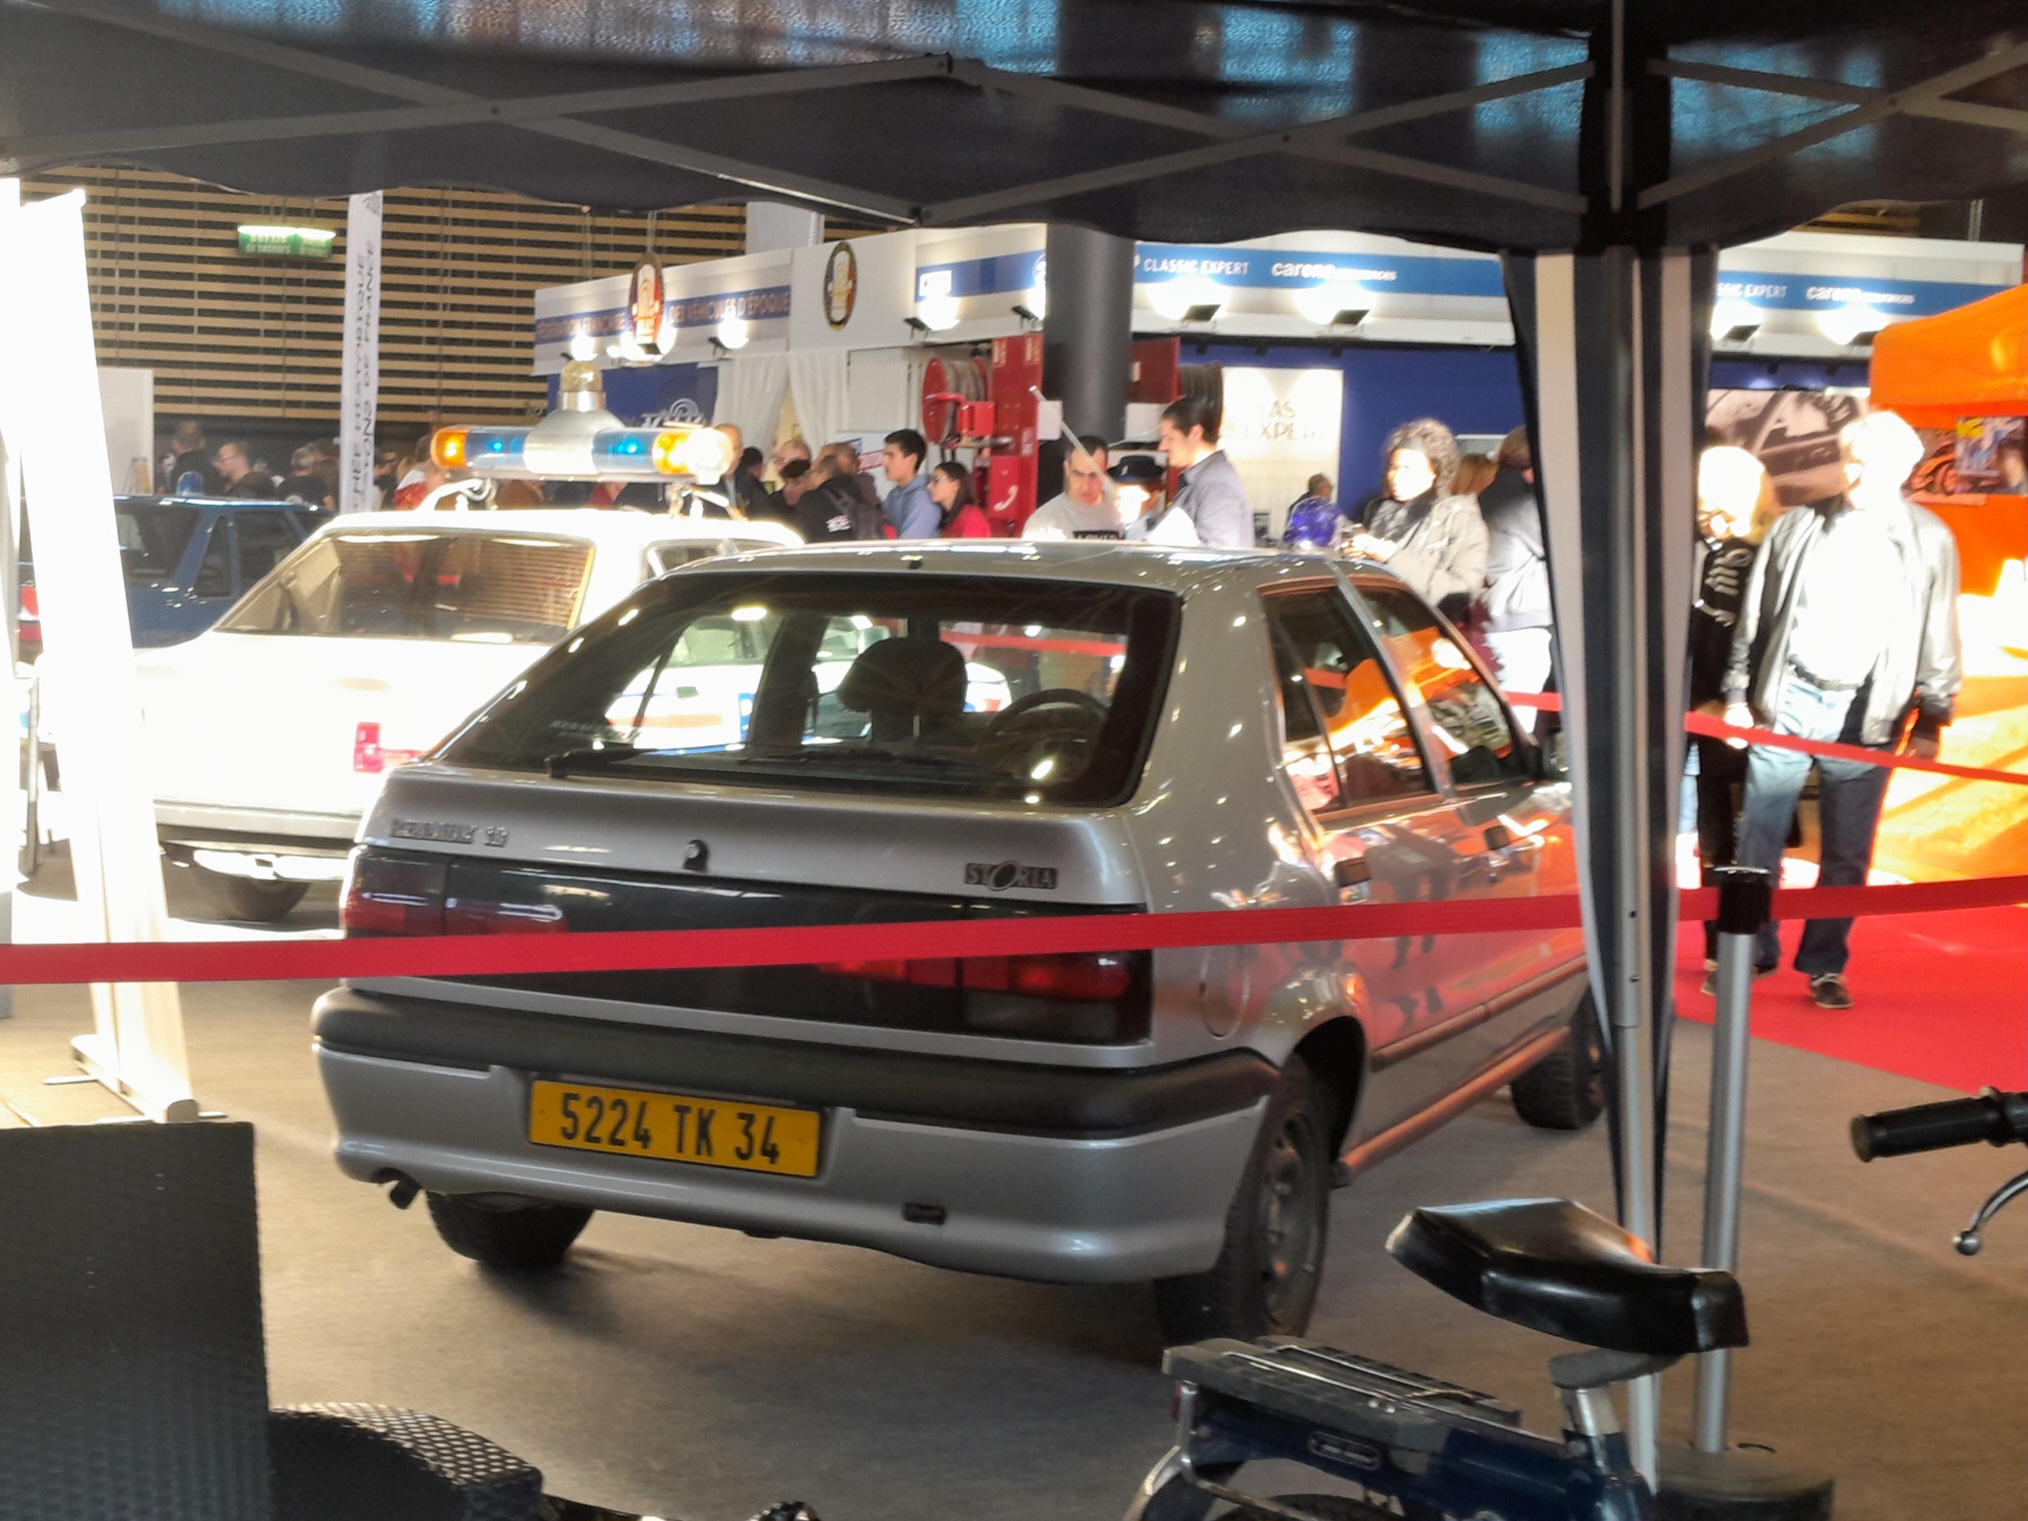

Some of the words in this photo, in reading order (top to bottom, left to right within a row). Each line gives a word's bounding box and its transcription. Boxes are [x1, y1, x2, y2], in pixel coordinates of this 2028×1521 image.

[1143, 257, 1199, 275] CLASSIC
[1199, 259, 1250, 276] EXPERT
[1744, 283, 1788, 298] EXPERT
[964, 860, 1059, 892] STORIA
[560, 1092, 652, 1150] 5224
[673, 1104, 716, 1157] TK
[735, 1112, 780, 1165] 34
